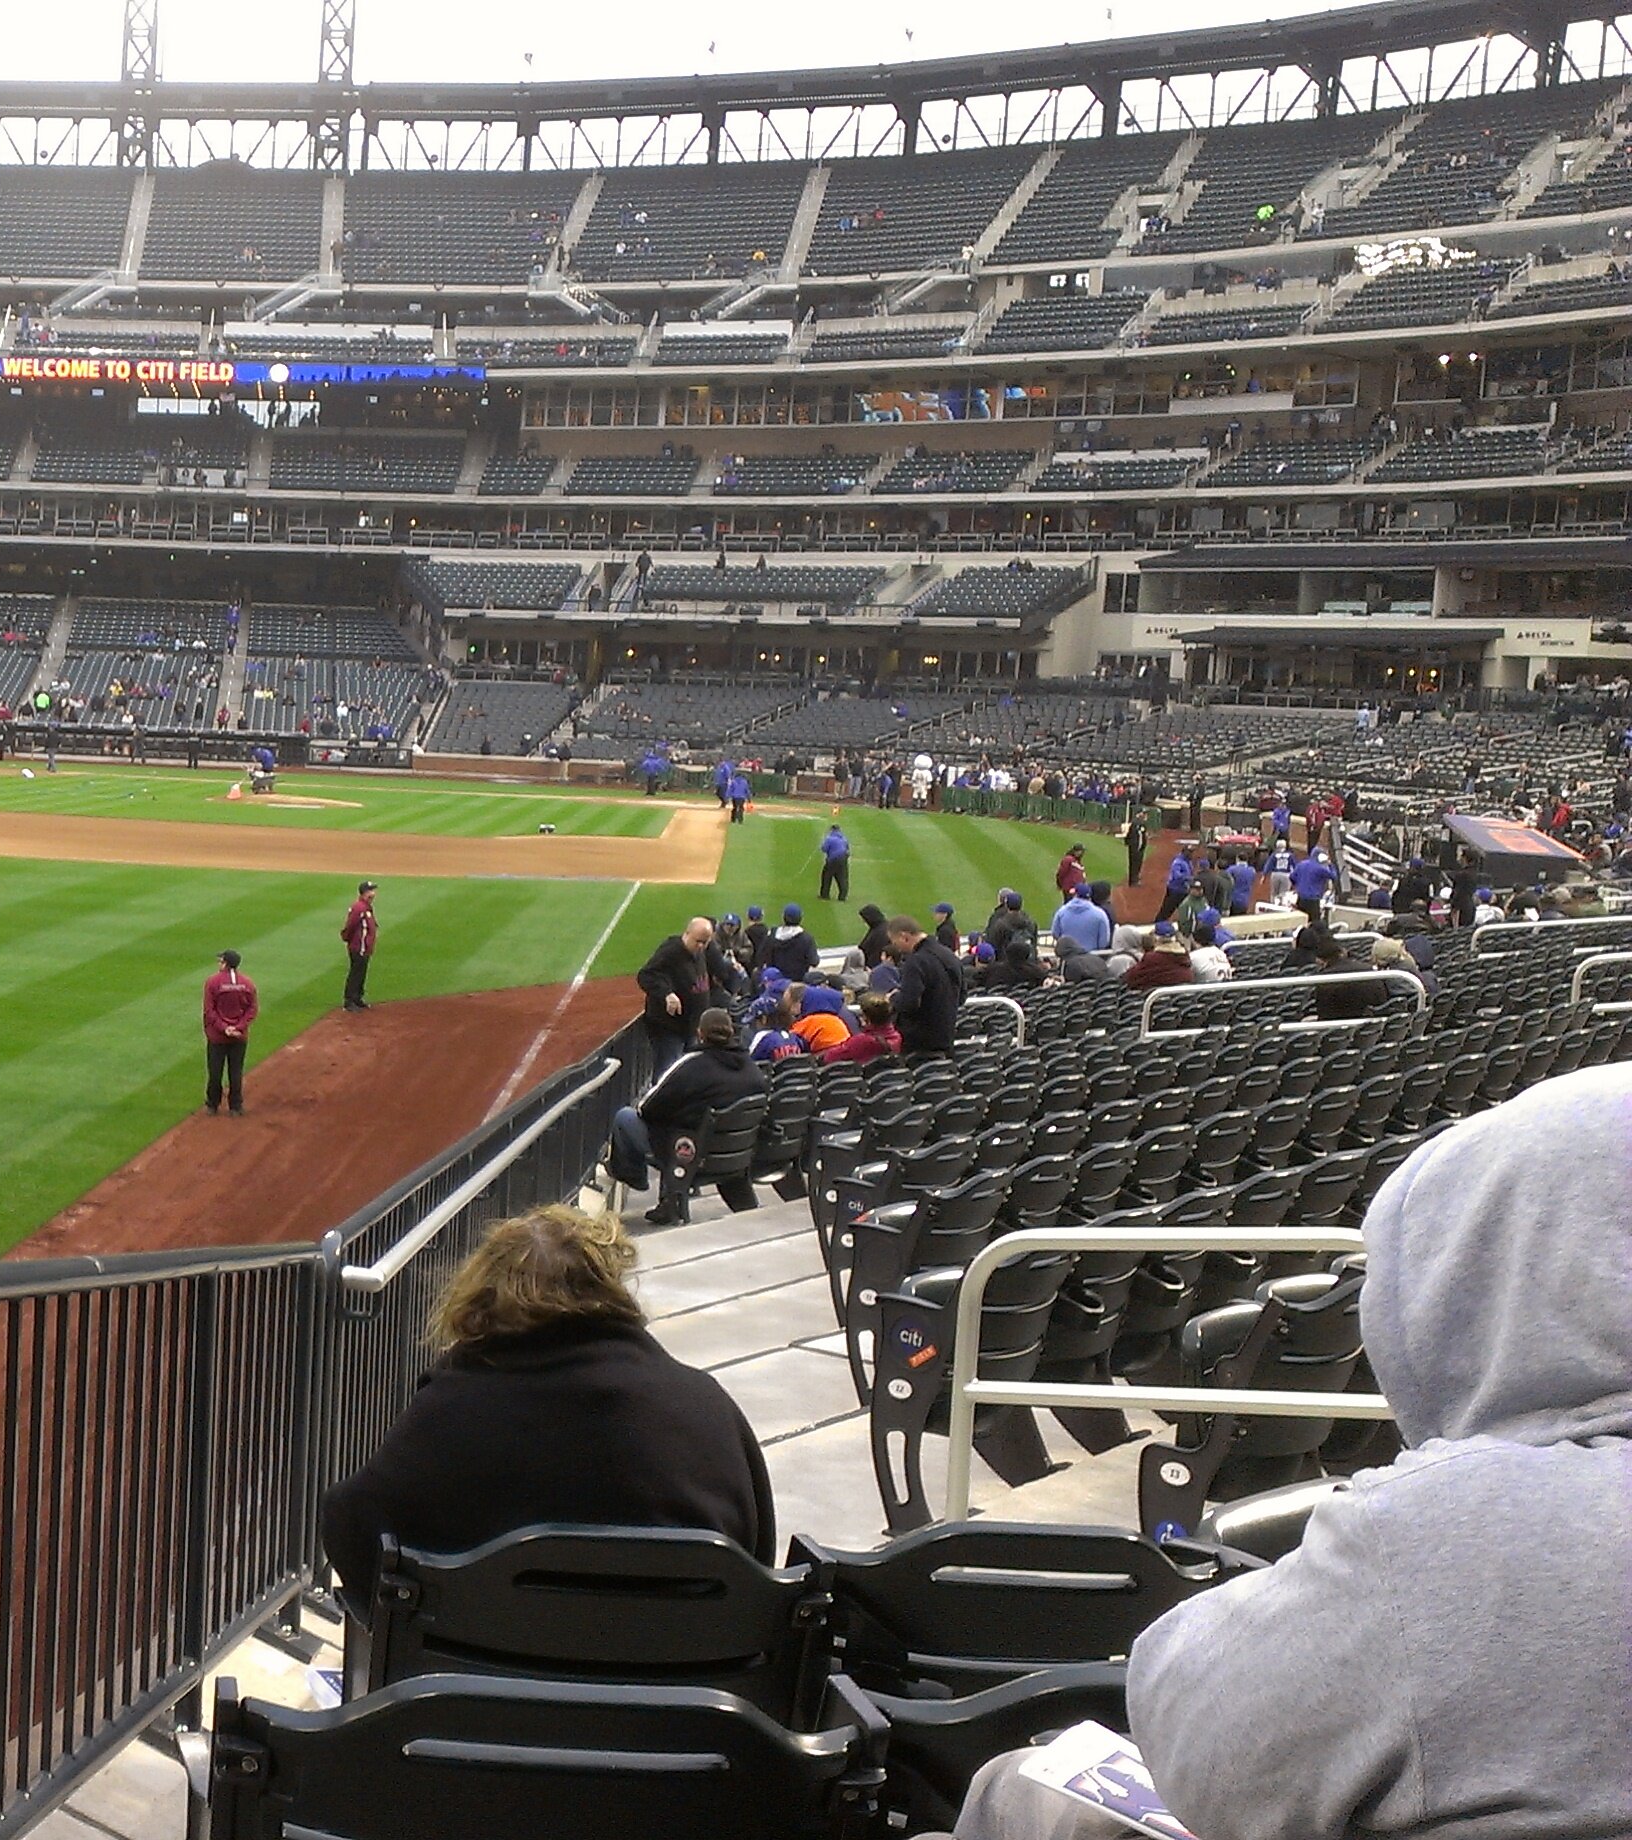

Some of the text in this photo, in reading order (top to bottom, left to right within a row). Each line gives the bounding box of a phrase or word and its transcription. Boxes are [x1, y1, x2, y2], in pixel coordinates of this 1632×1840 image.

[3, 358, 234, 382] WELCOME TO CITI FIELD
[900, 1329, 923, 1348] citi
